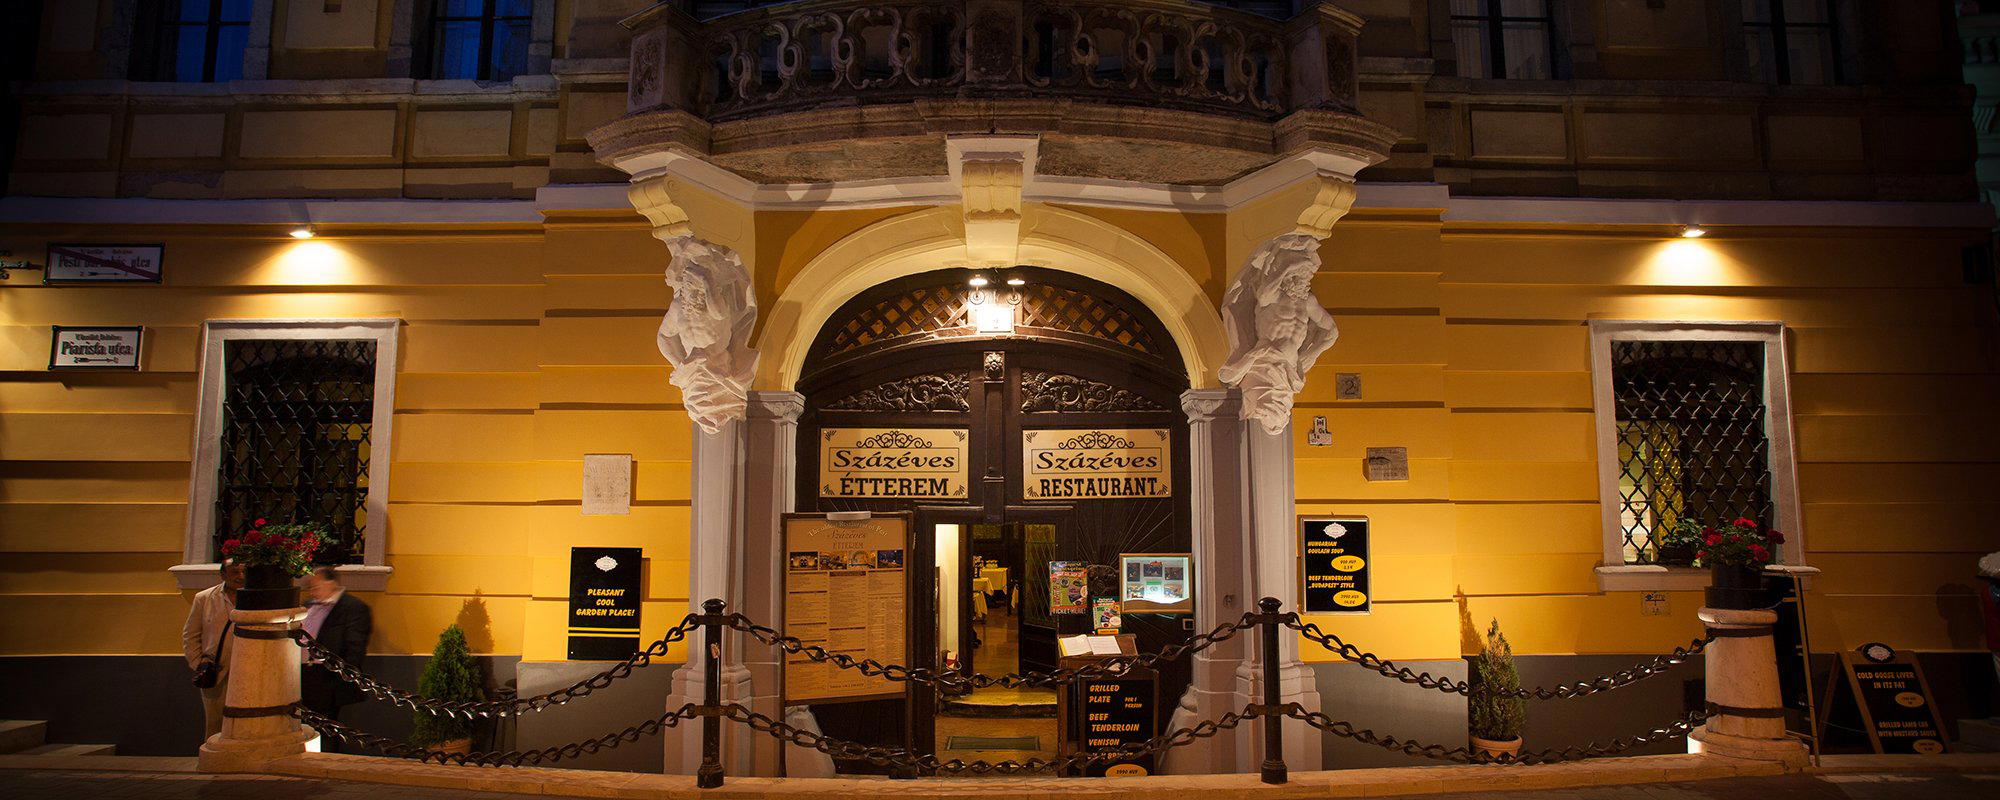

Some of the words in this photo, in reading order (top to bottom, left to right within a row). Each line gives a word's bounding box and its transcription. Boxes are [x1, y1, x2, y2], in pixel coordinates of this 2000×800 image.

[61, 341, 107, 355] Piarista
[108, 342, 132, 355] utca
[834, 448, 955, 470] Százéves
[1036, 449, 1158, 471] Százéves
[840, 473, 950, 497] ÉTTEREM
[1040, 477, 1158, 498] RESTAURANT
[587, 588, 625, 596] PLEASANT
[576, 608, 607, 616] GARDEN
[608, 608, 635, 616] PLACE!
[1857, 671, 1873, 679] COLD
[1090, 684, 1120, 692] GRILLED
[1089, 695, 1111, 703] PLATE
[1089, 713, 1109, 721] BEEF
[1091, 723, 1140, 732] TENDERLOIN
[1088, 738, 1120, 746] VENISON
